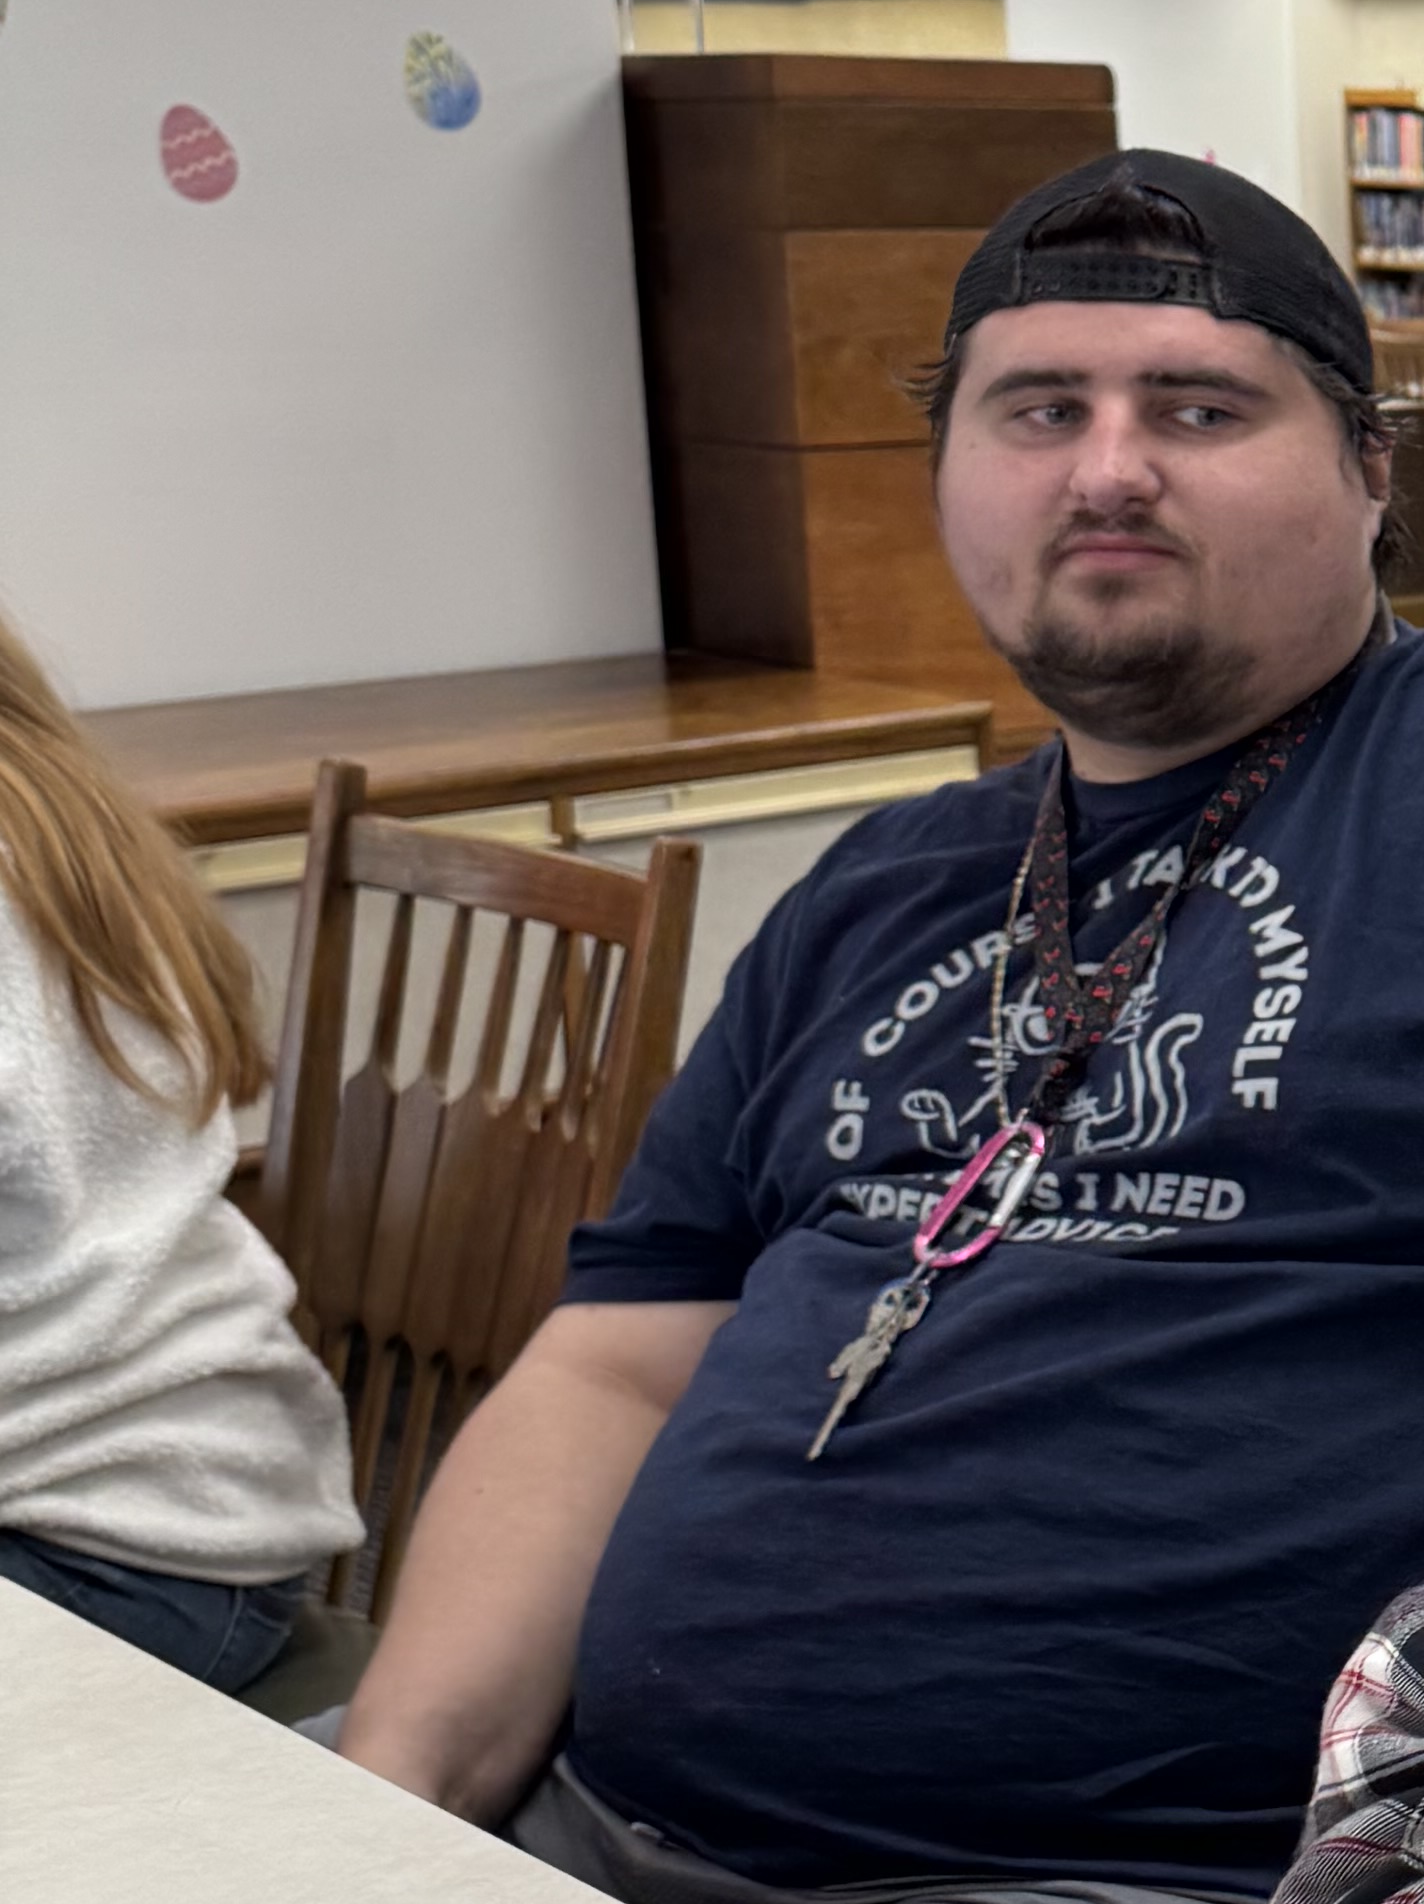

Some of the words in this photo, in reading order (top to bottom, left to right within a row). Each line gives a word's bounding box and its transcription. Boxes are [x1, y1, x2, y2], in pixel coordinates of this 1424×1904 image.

[826, 1078, 870, 1161] OF
[861, 912, 1038, 1058] COURS
[1126, 844, 1249, 889] TAK
[1231, 904, 1309, 1112] MYSELF
[1074, 1172, 1099, 1211] I
[1111, 1171, 1247, 1223] NEED
